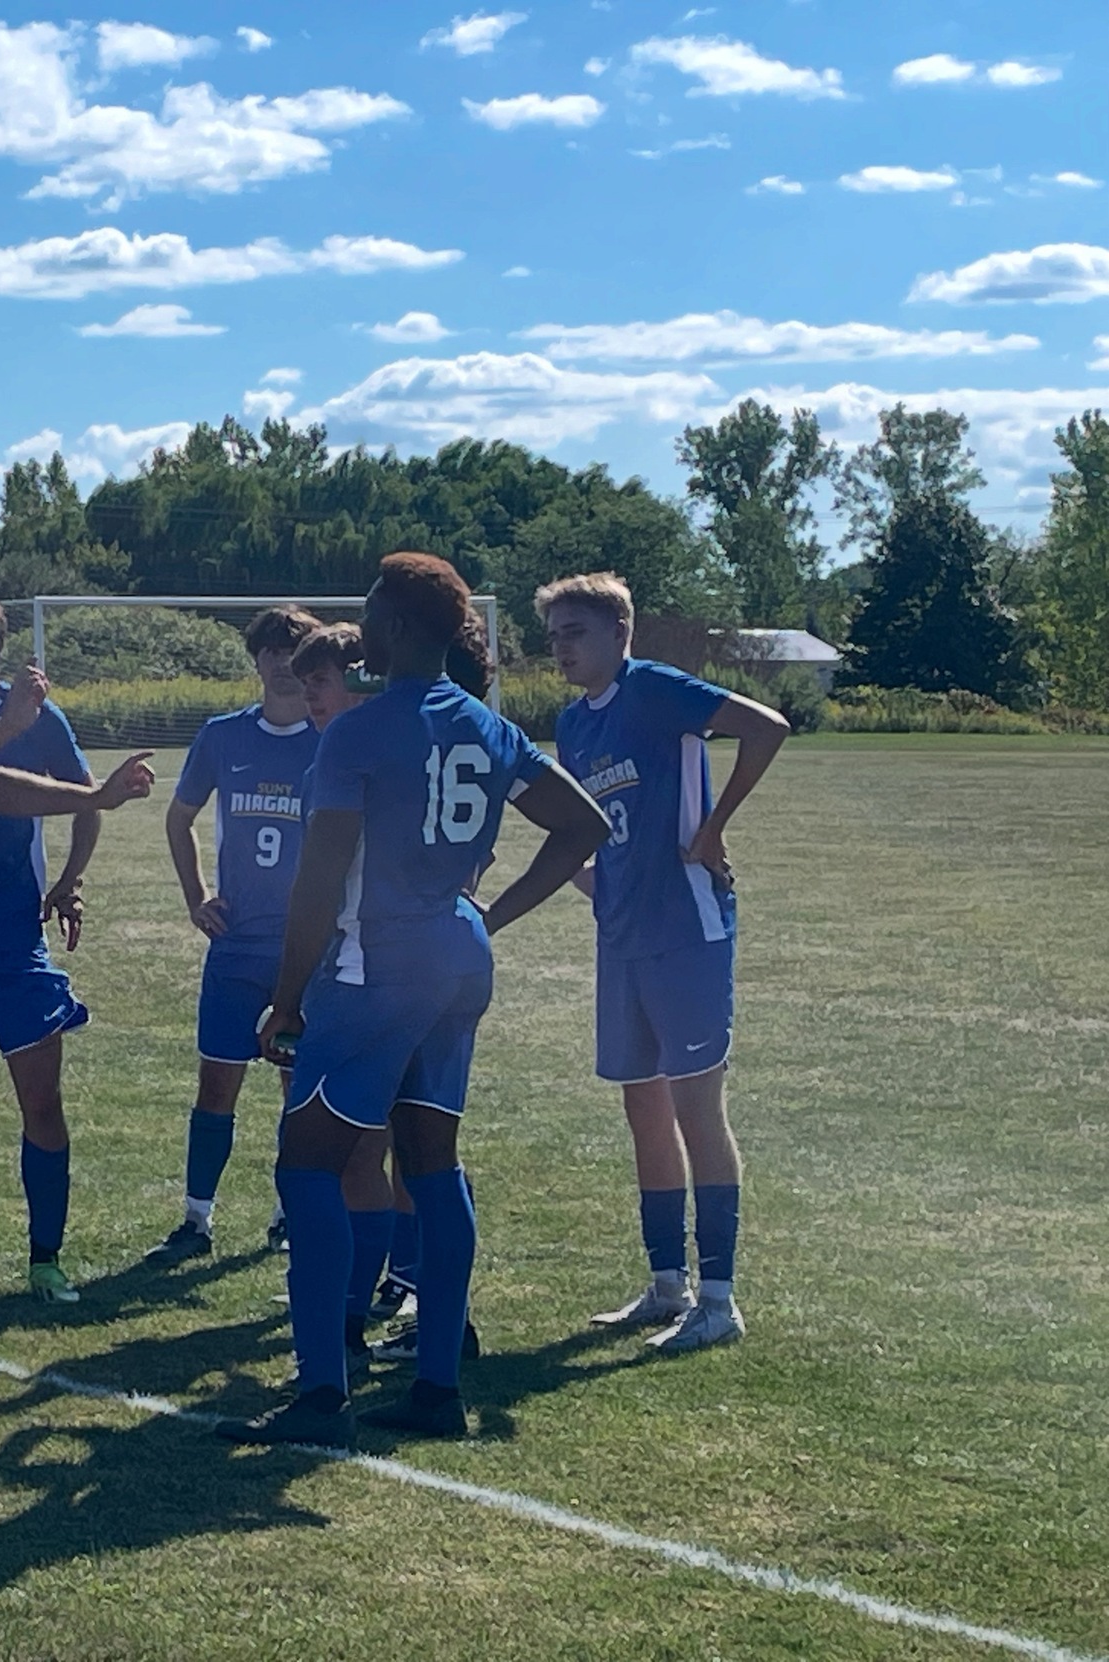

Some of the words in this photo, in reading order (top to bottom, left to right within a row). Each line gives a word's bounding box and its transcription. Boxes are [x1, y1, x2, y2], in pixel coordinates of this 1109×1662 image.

[231, 793, 301, 816] NIAGAR
[257, 783, 293, 795] SUNY
[422, 744, 492, 845] 16
[256, 827, 282, 867] 9
